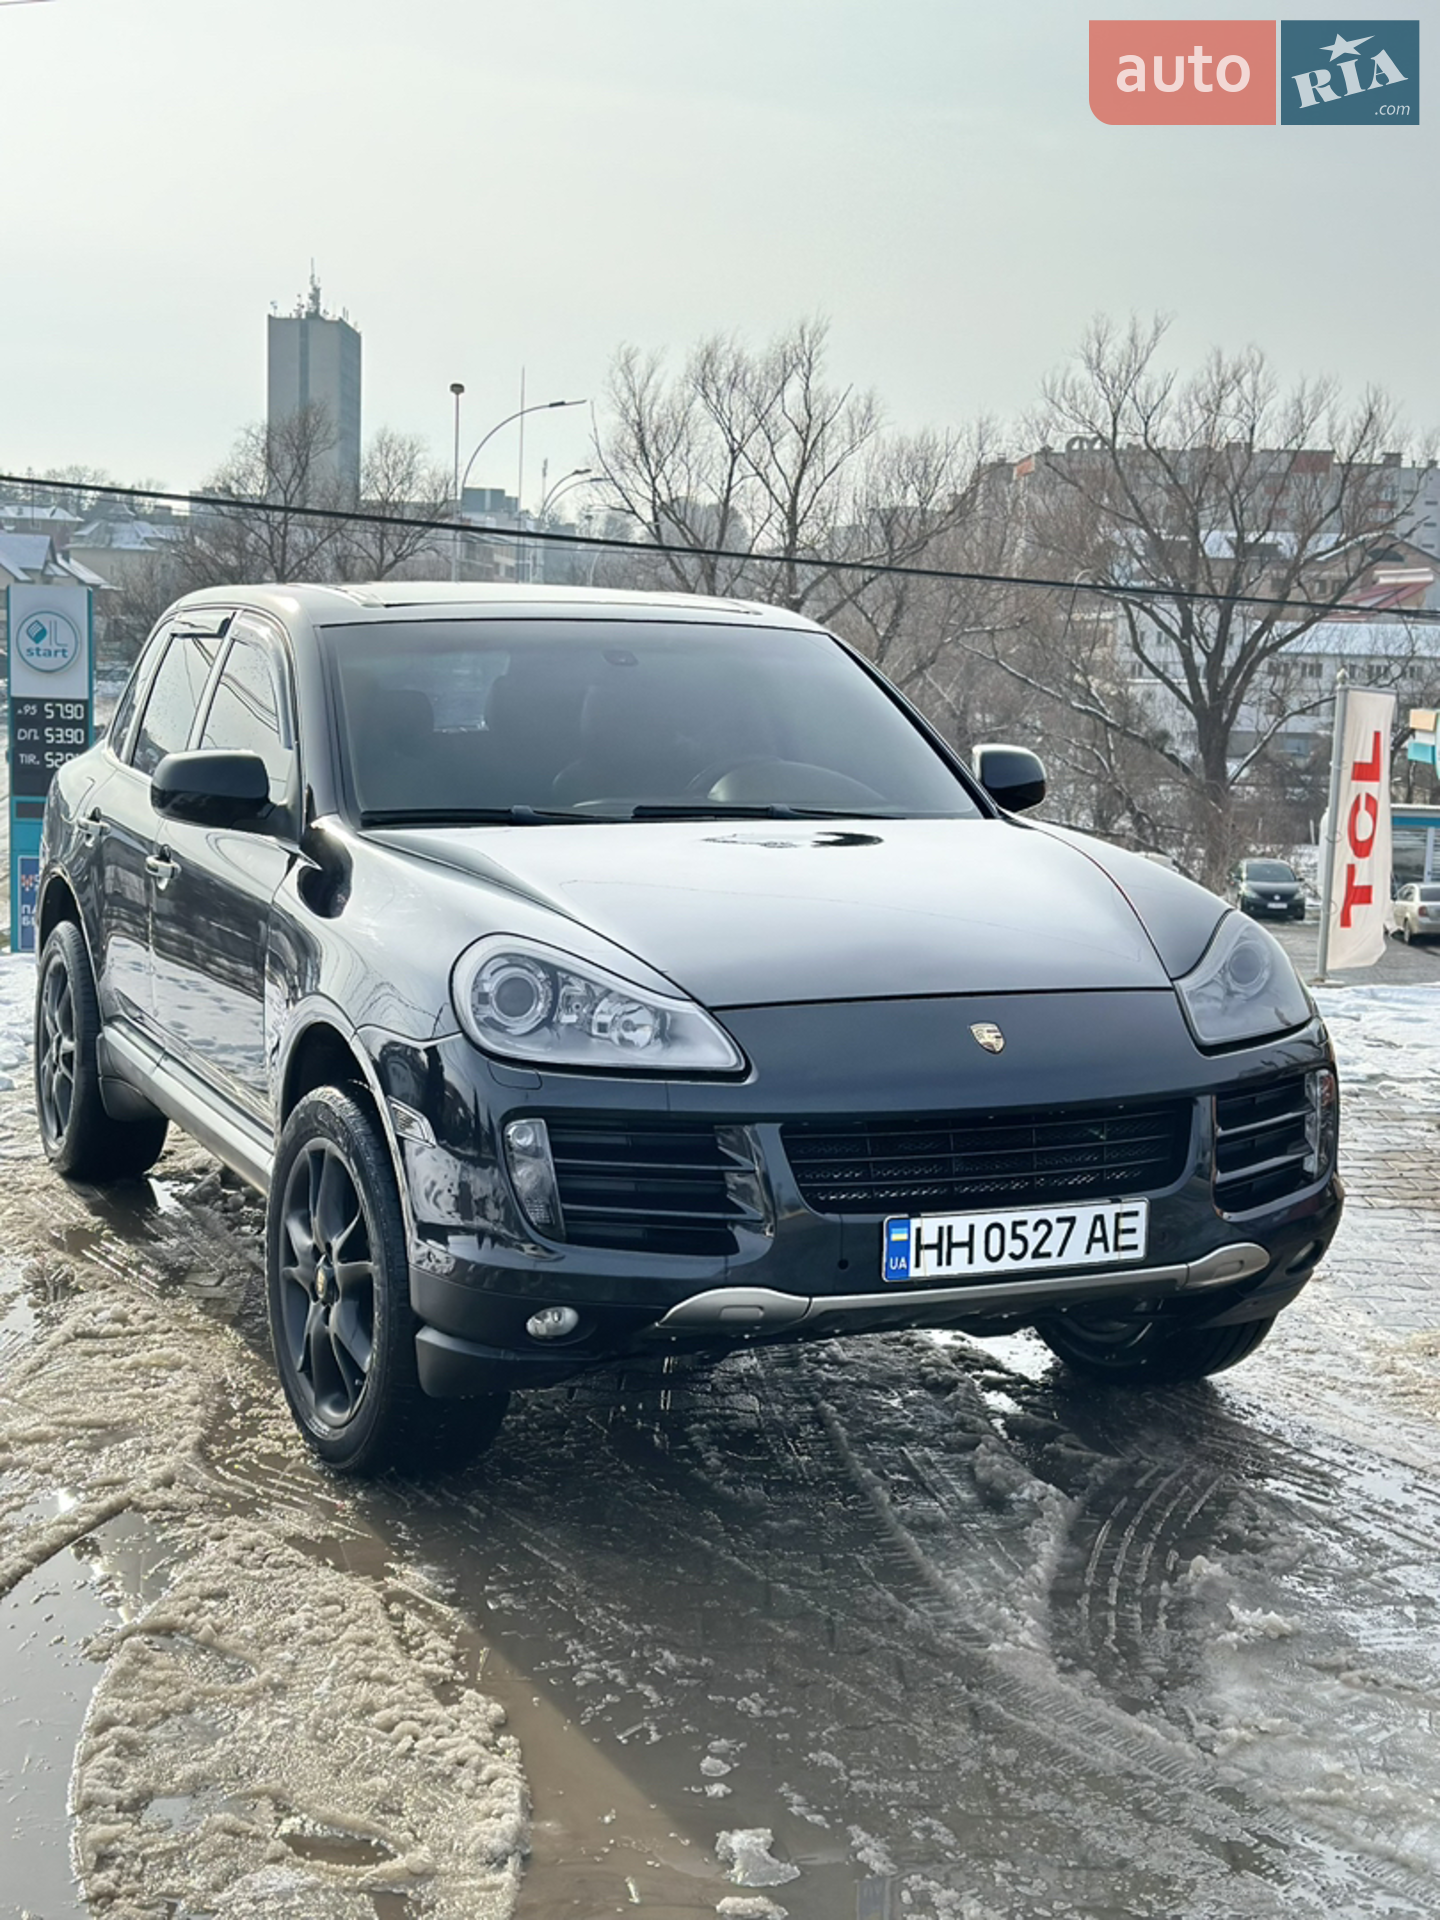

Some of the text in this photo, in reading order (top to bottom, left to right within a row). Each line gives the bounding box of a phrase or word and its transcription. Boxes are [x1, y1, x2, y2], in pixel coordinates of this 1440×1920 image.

[26, 646, 69, 659] start
[1340, 731, 1381, 928] TCL
[914, 1210, 1140, 1268] HH 0527 AE
[889, 1256, 907, 1270] UA
